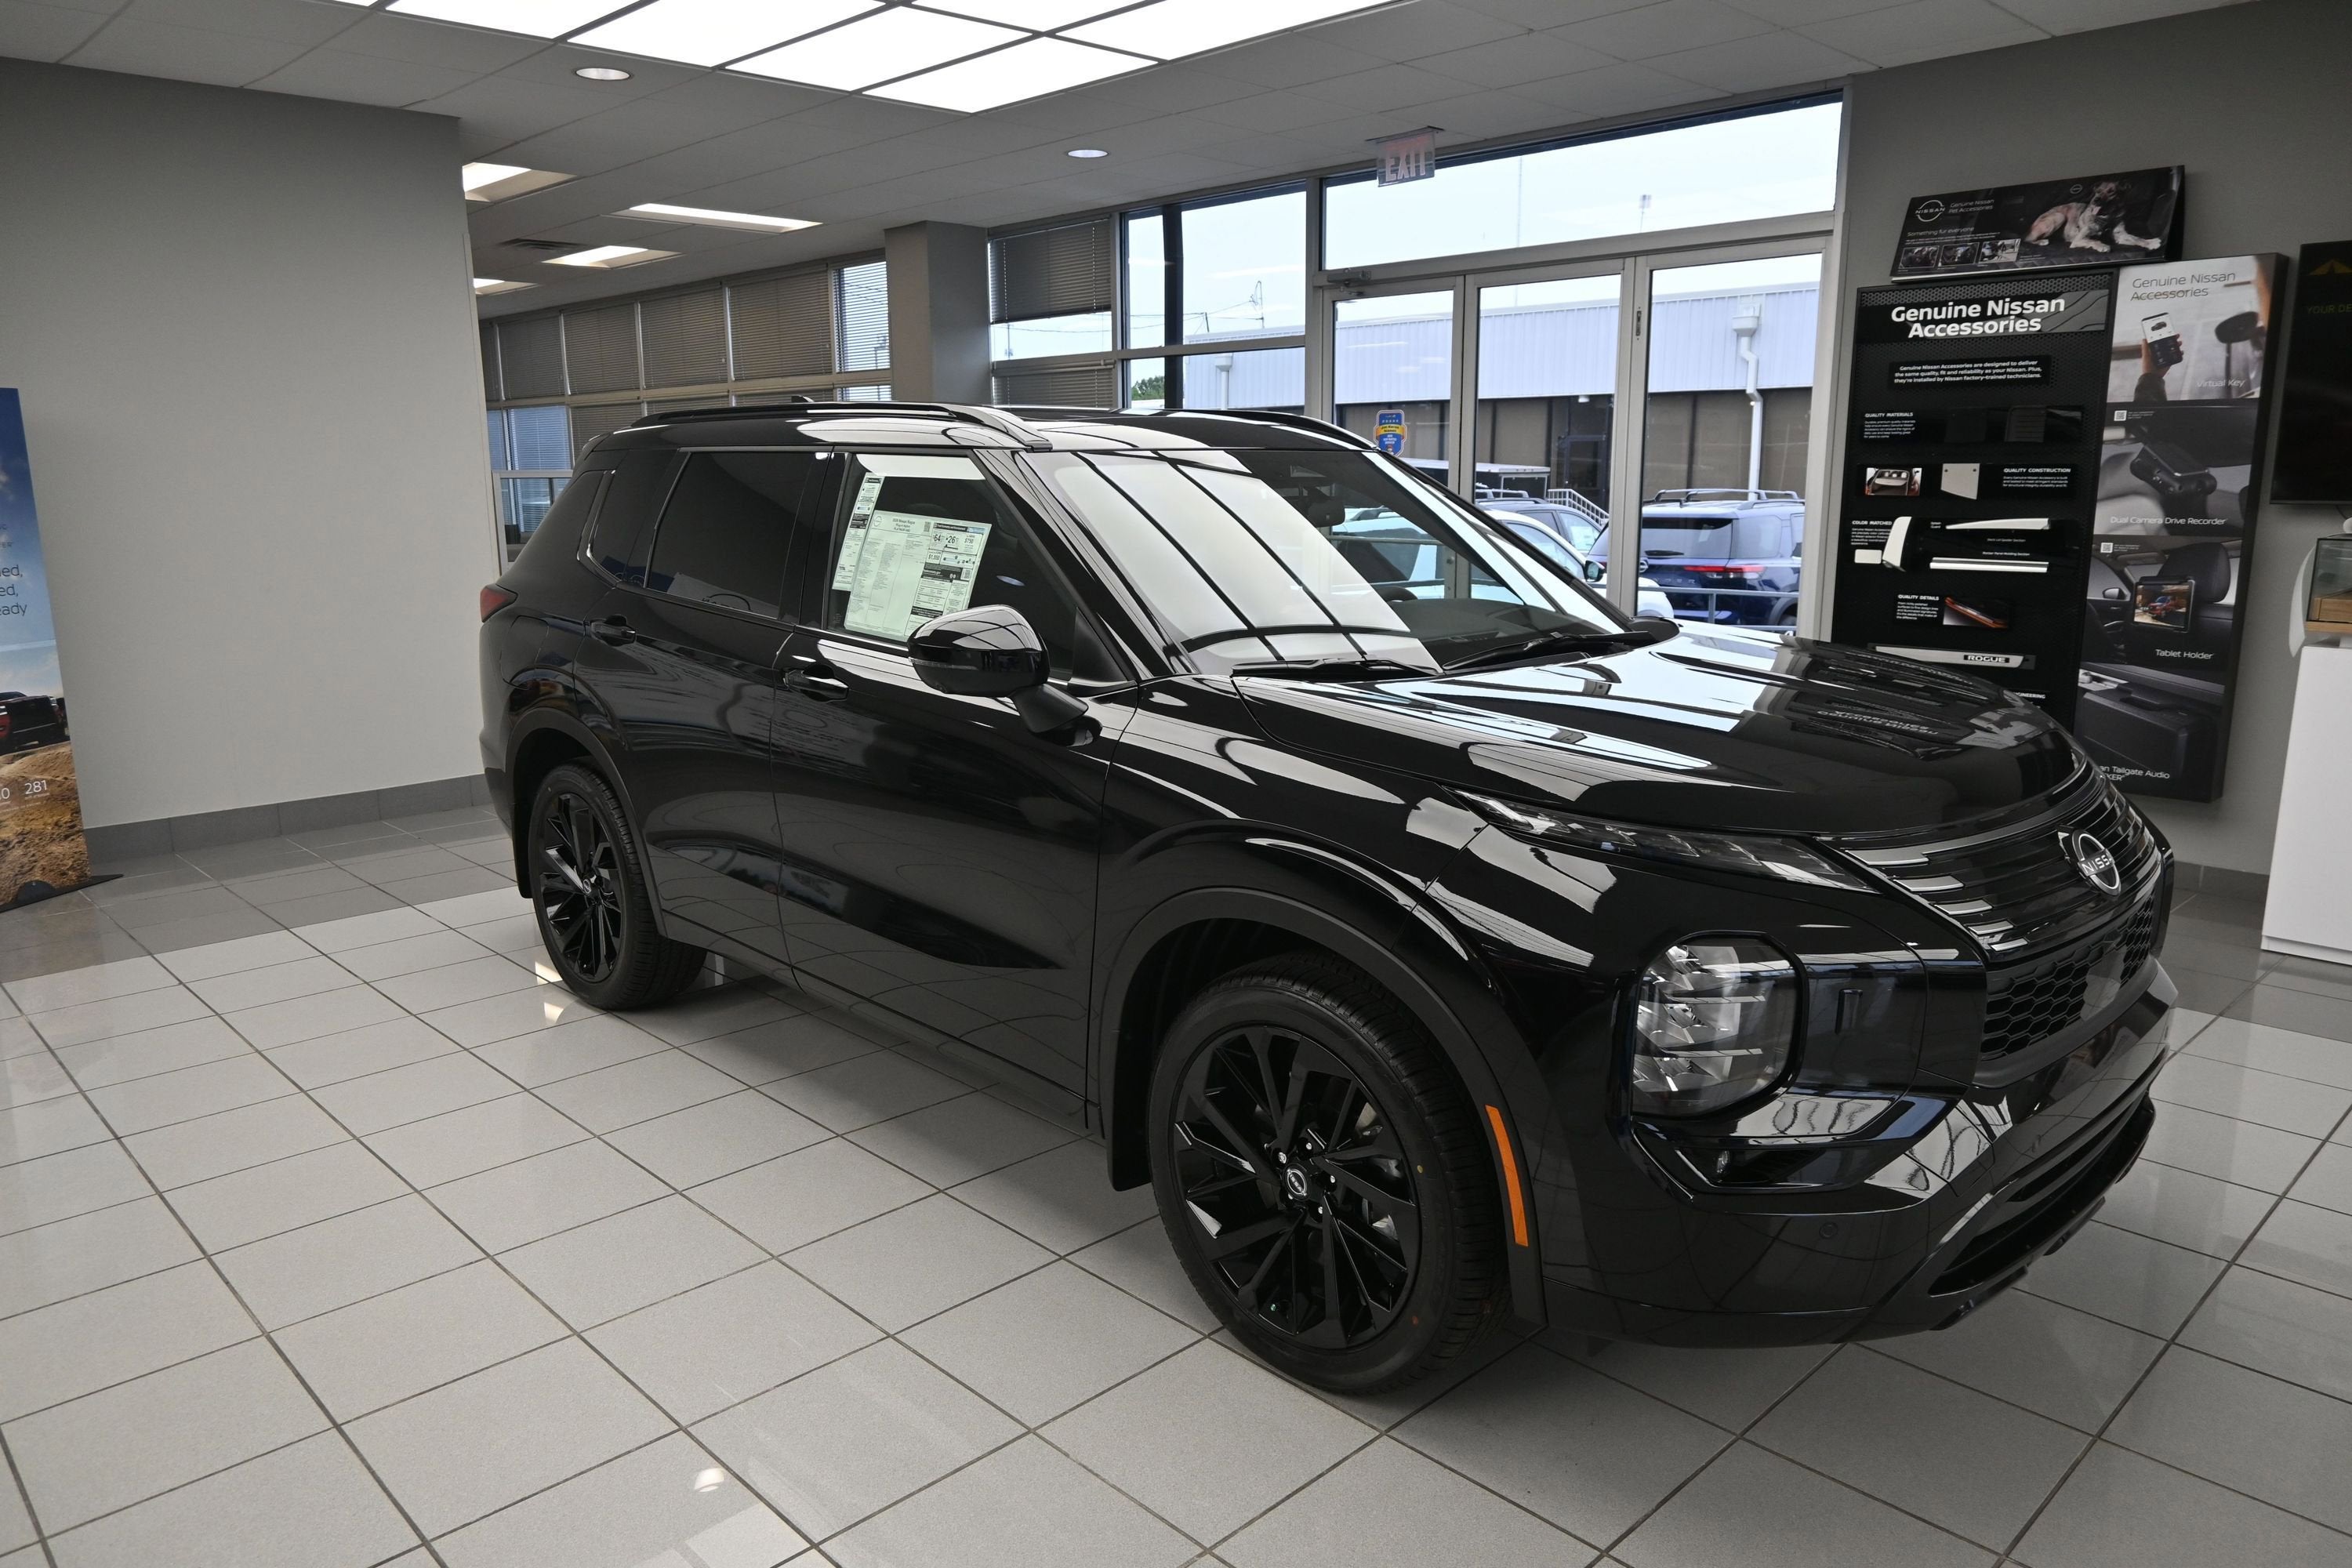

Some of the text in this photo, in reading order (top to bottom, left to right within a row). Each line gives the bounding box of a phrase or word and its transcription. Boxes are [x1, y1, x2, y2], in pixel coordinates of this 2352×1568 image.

[1385, 134, 1430, 182] EXIT
[2132, 272, 2236, 289] Genuine Nissan
[2130, 287, 2209, 301] Accessories
[1891, 298, 2065, 322] Genuine Nissan
[1908, 315, 2042, 338] Accessories
[0, 564, 23, 578] ed,
[2155, 649, 2181, 658] Tablet
[2112, 766, 2143, 776] Tailgate
[2144, 770, 2170, 779] Audio
[24, 779, 47, 794] 281
[2082, 855, 2112, 874] NISS
